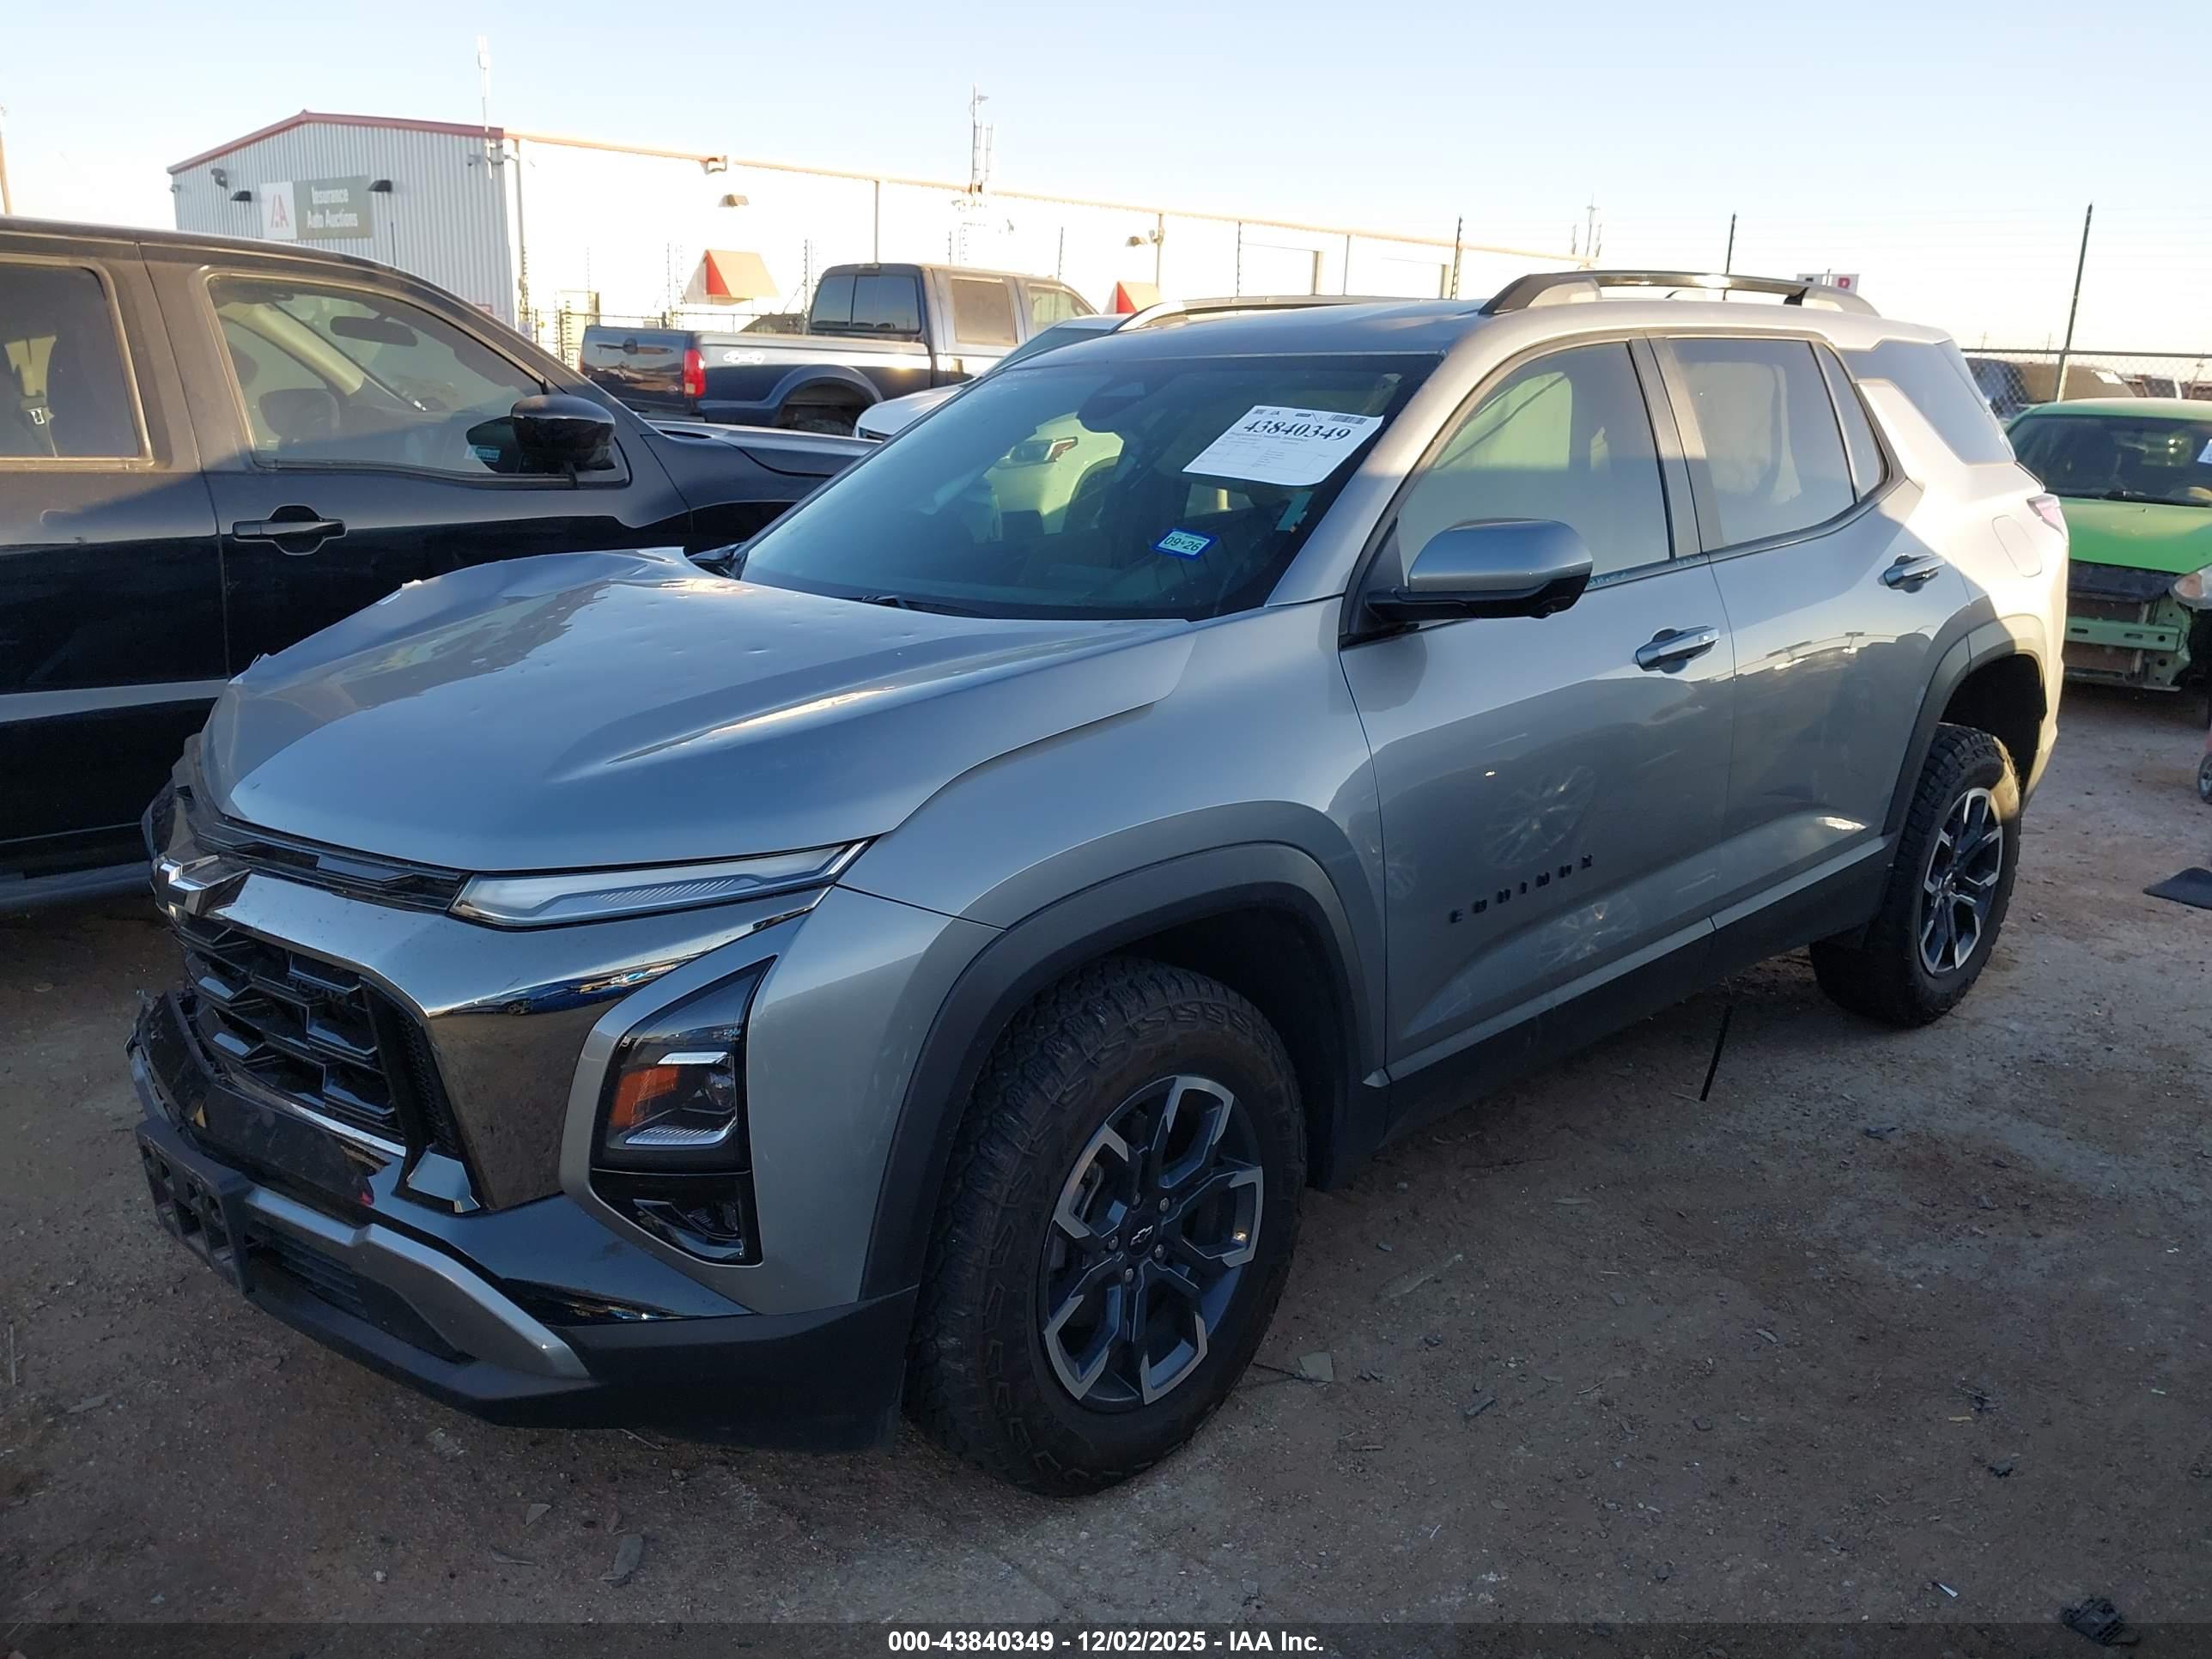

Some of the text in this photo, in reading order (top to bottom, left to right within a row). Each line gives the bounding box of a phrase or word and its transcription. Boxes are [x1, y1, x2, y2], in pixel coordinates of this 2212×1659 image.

[311, 186, 349, 205] Insurance
[307, 207, 358, 228] Auto Auctions
[1243, 419, 1352, 441] 43840349
